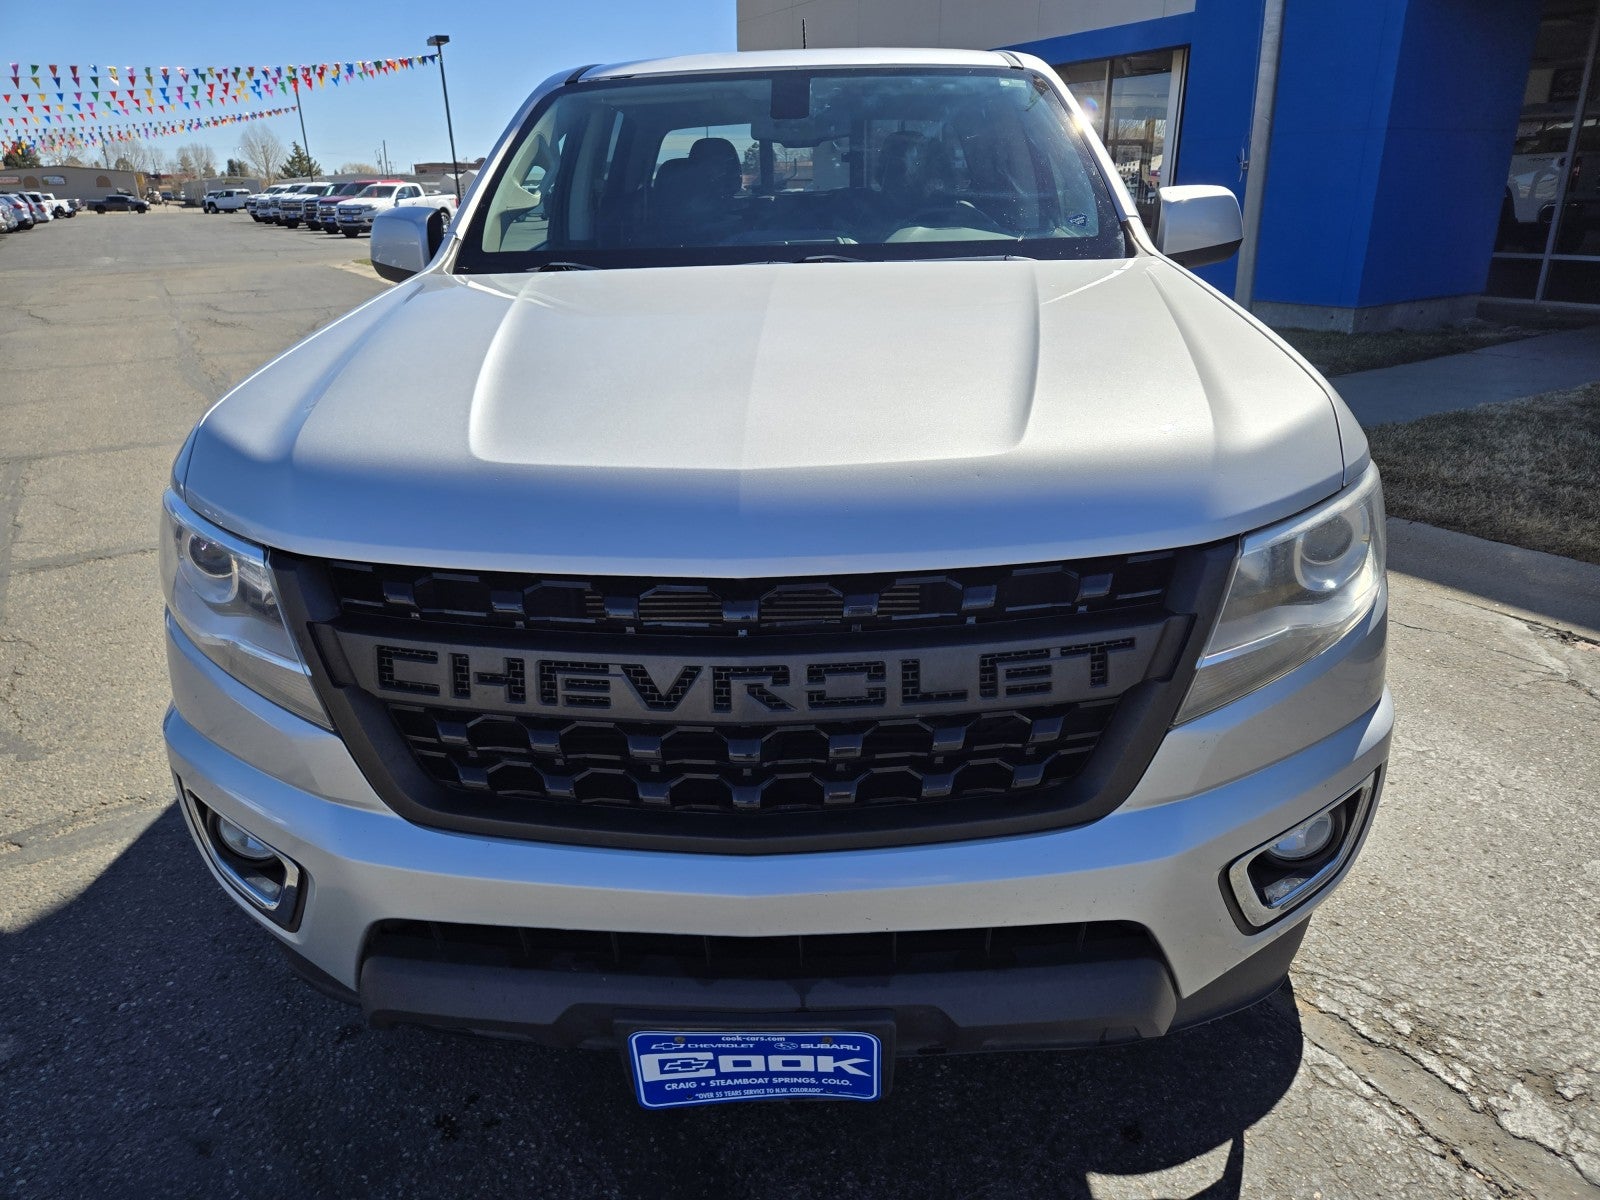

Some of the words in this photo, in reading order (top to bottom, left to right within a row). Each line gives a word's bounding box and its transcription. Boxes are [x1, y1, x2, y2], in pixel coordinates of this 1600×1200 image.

[376, 637, 1136, 712] CHEVROLET
[800, 1043, 861, 1051] SUBARU
[665, 1081, 698, 1091] CRAIG
[709, 1077, 769, 1087] STEAMBOAT
[772, 1077, 819, 1085] SPRINGS,
[821, 1078, 853, 1086] COLO.
